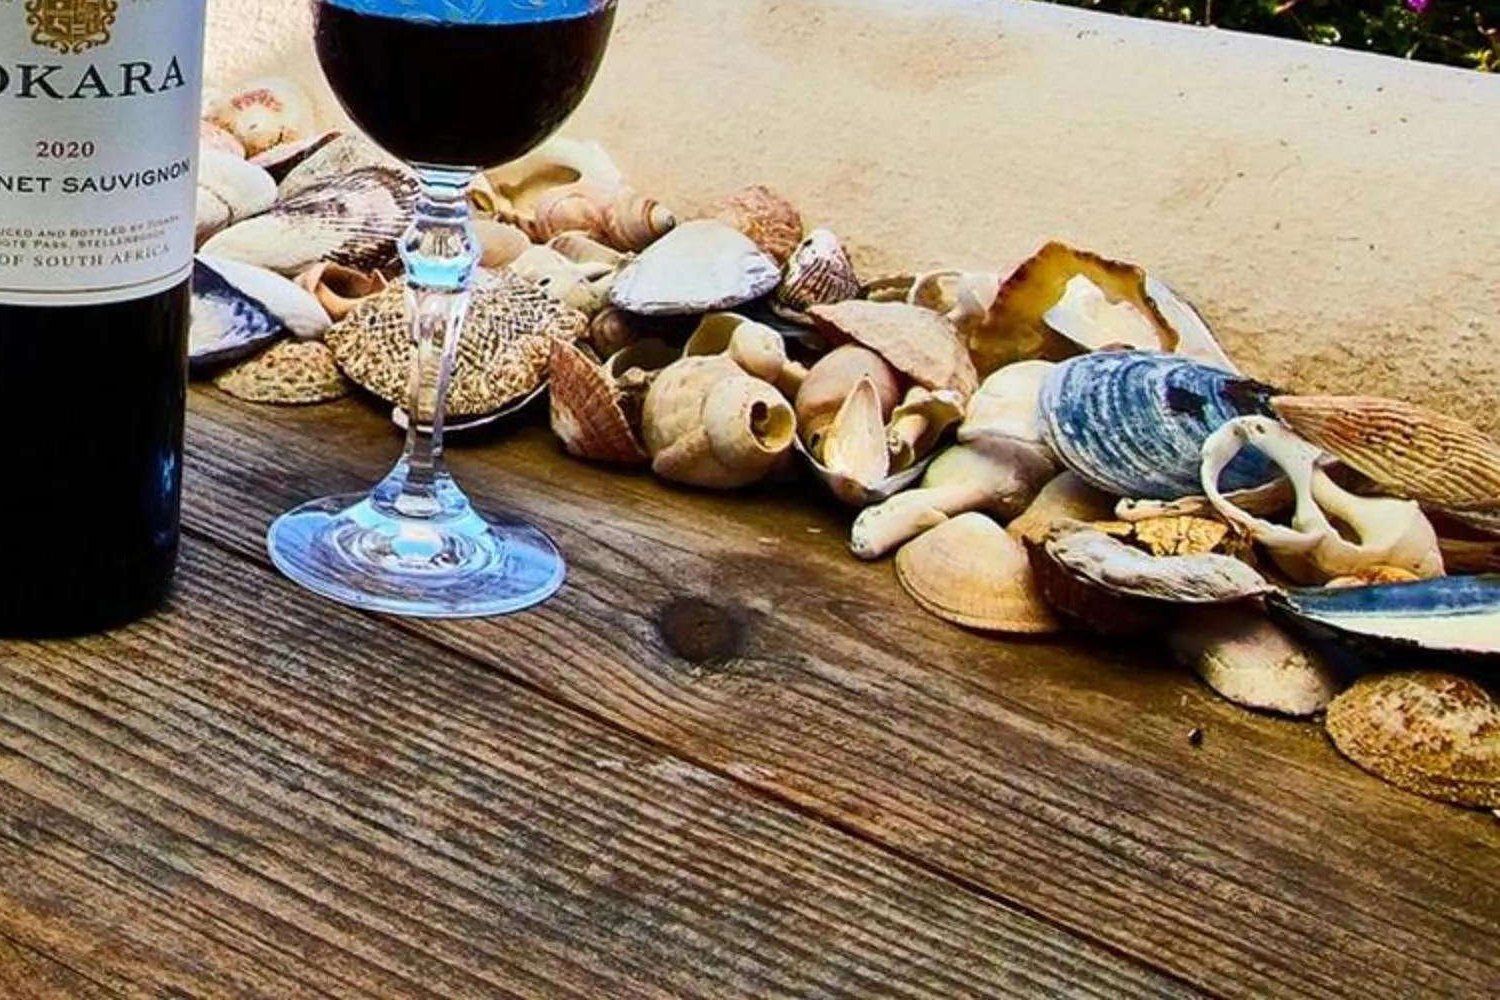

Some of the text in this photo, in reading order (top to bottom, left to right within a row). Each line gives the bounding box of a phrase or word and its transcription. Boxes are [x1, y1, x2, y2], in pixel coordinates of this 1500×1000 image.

[36, 140, 95, 159] 2020
[62, 157, 190, 194] SAUVIGNON
[38, 229, 65, 239] AND
[69, 226, 127, 239] BOTTLED
[33, 253, 103, 268] SOUTH
[110, 243, 170, 265] AFRICA
